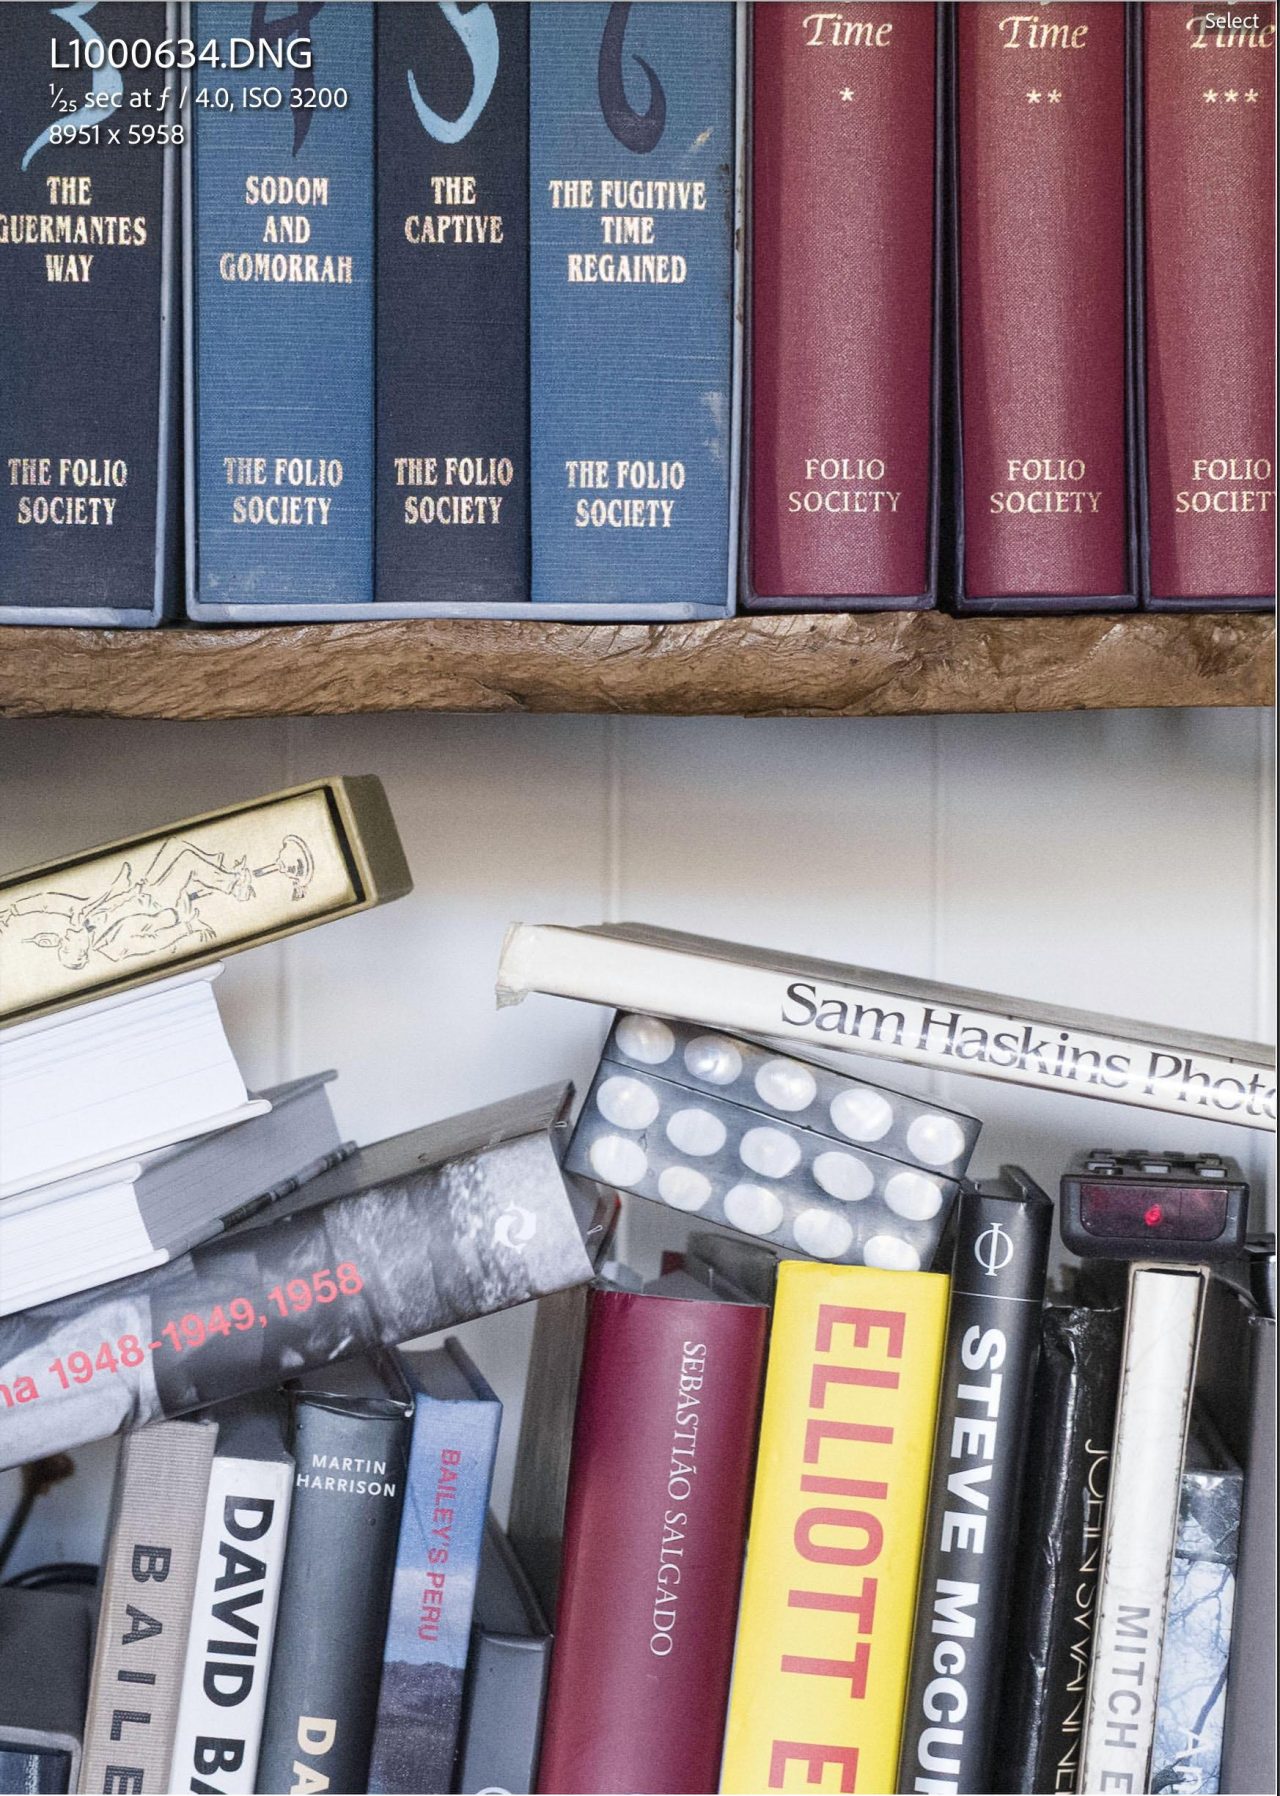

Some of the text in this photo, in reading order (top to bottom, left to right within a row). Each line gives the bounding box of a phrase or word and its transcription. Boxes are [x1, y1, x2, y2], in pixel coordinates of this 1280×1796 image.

[803, 13, 893, 48] Time
[998, 15, 1089, 49] Time
[46, 176, 92, 205] THE
[245, 176, 329, 206] SODOM
[431, 175, 476, 205] THE
[549, 180, 707, 210] THE FUGITIVE
[262, 215, 311, 244] AND
[404, 214, 504, 245] CAPTIVE
[601, 216, 655, 245] TIME
[45, 254, 94, 282] WAY
[219, 253, 353, 284] GOMORRAH
[567, 254, 687, 283] REGAINED
[8, 458, 128, 487] THE FOLIO
[223, 456, 343, 487] THE FOLIO
[394, 457, 514, 486] THE FOLIO
[565, 460, 685, 490] THE FOLIO
[804, 458, 885, 480] FOLIO
[1006, 458, 1086, 481] FOLIO
[1192, 458, 1271, 481] FOLIO
[17, 496, 117, 525] SOCIETY
[232, 496, 332, 525] SOCIETY
[404, 496, 503, 525] SOCIETY
[575, 499, 675, 528] SOCIETY
[788, 490, 902, 514] SOCIETY
[989, 491, 1103, 514] SOCIETY
[1175, 491, 1276, 513] SOCIET
[782, 982, 905, 1046] Sam
[915, 1007, 1131, 1090] Haskins
[940, 1324, 1008, 1555] STEVE
[311, 1453, 387, 1476] MARTIN
[295, 1472, 397, 1498] HARRISON
[649, 1341, 708, 1657] SEBASTIÃO SALGADO
[780, 1303, 907, 1700] ELLIOTT
[416, 1447, 463, 1643] BAILEY'S PERU
[202, 1495, 275, 1708] DAVID
[1103, 1604, 1152, 1751] MITCH
